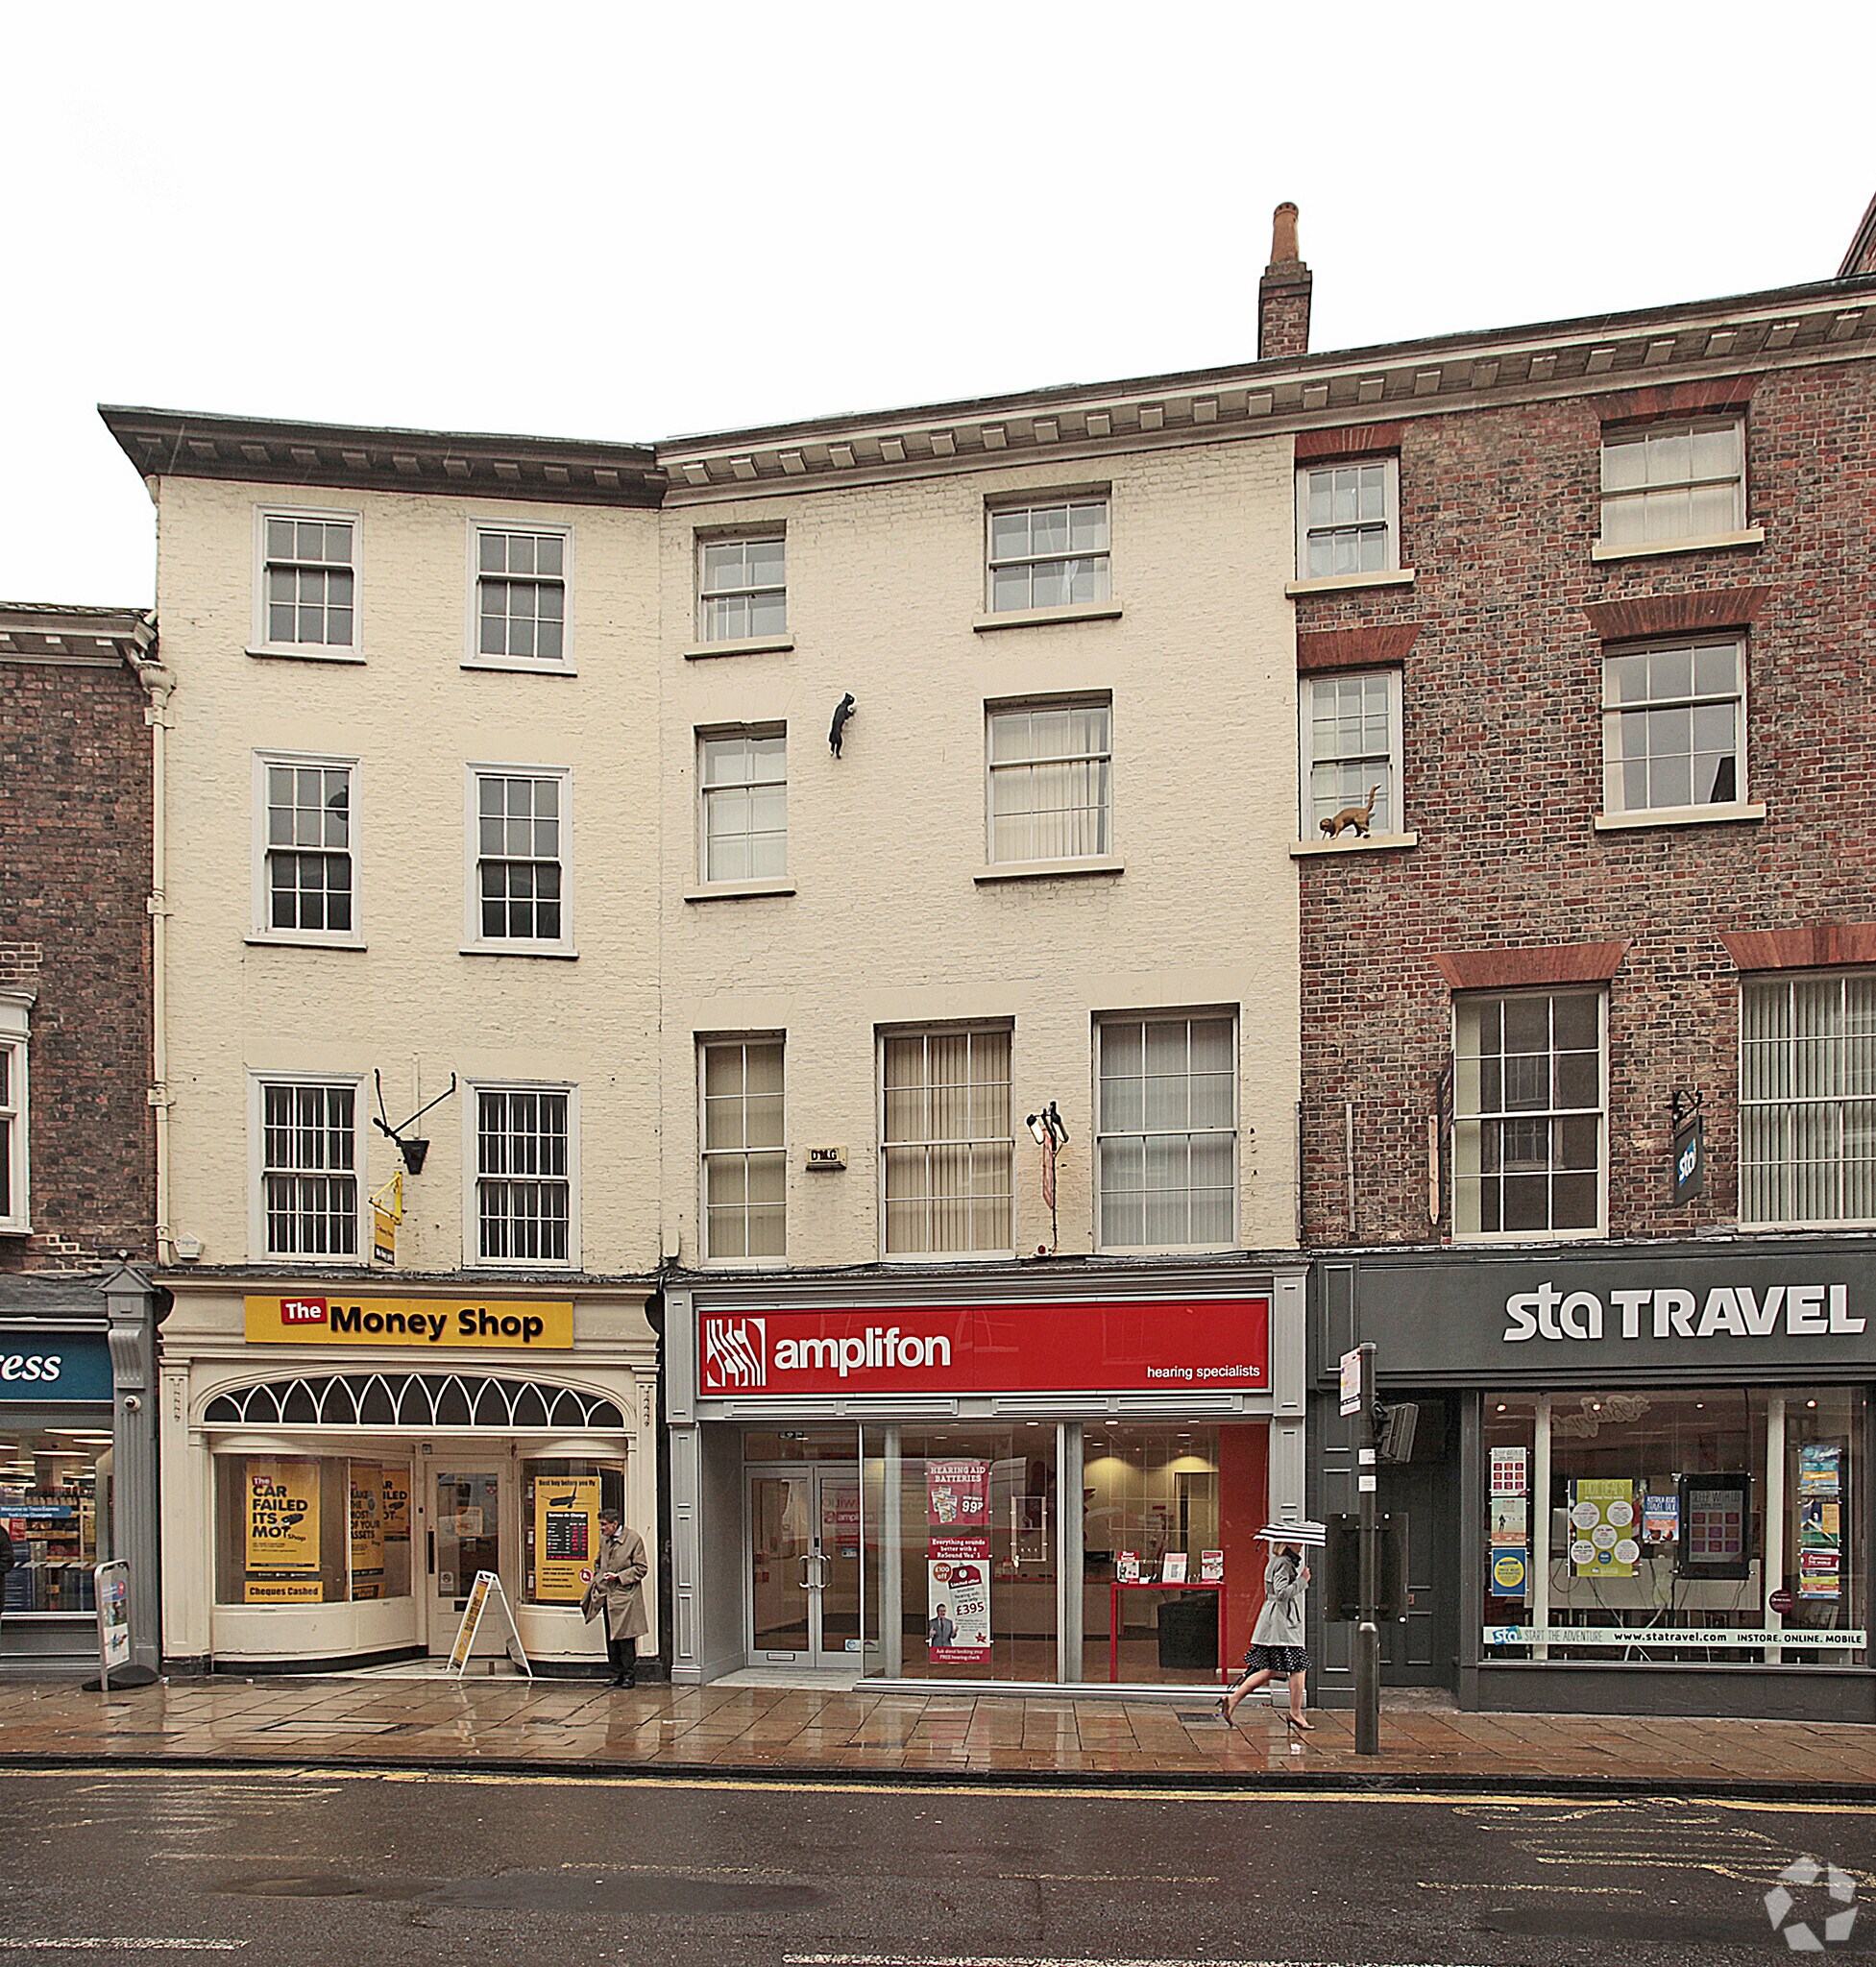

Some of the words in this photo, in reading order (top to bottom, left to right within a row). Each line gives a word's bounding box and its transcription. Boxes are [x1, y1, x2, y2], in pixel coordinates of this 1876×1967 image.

[1503, 1281, 1603, 1341] sta
[1611, 1284, 1866, 1338] TRAVEL
[285, 1302, 322, 1320] The
[329, 1305, 447, 1341] Money
[458, 1308, 544, 1343] Shop
[774, 1327, 951, 1377] amplifon
[1147, 1366, 1193, 1380] hearing
[1196, 1365, 1260, 1379] specialists
[253, 1485, 287, 1497] CAR
[253, 1498, 308, 1511] FAILED
[253, 1512, 278, 1524] ITS
[252, 1525, 291, 1539] MOT
[932, 1538, 964, 1546] Everything
[250, 1587, 286, 1596] Cheques
[287, 1587, 319, 1595] Cashed
[956, 1601, 985, 1615] £395
[1495, 1628, 1518, 1642] sta
[1524, 1630, 1545, 1641] START
[1548, 1630, 1561, 1641] THE
[1563, 1630, 1603, 1642] ADVENTURE
[1614, 1632, 1727, 1641] www.statravel.com
[1737, 1634, 1782, 1642] INSTORE.
[1784, 1634, 1823, 1643] ONLINE.
[1825, 1635, 1862, 1643] MOBILE
